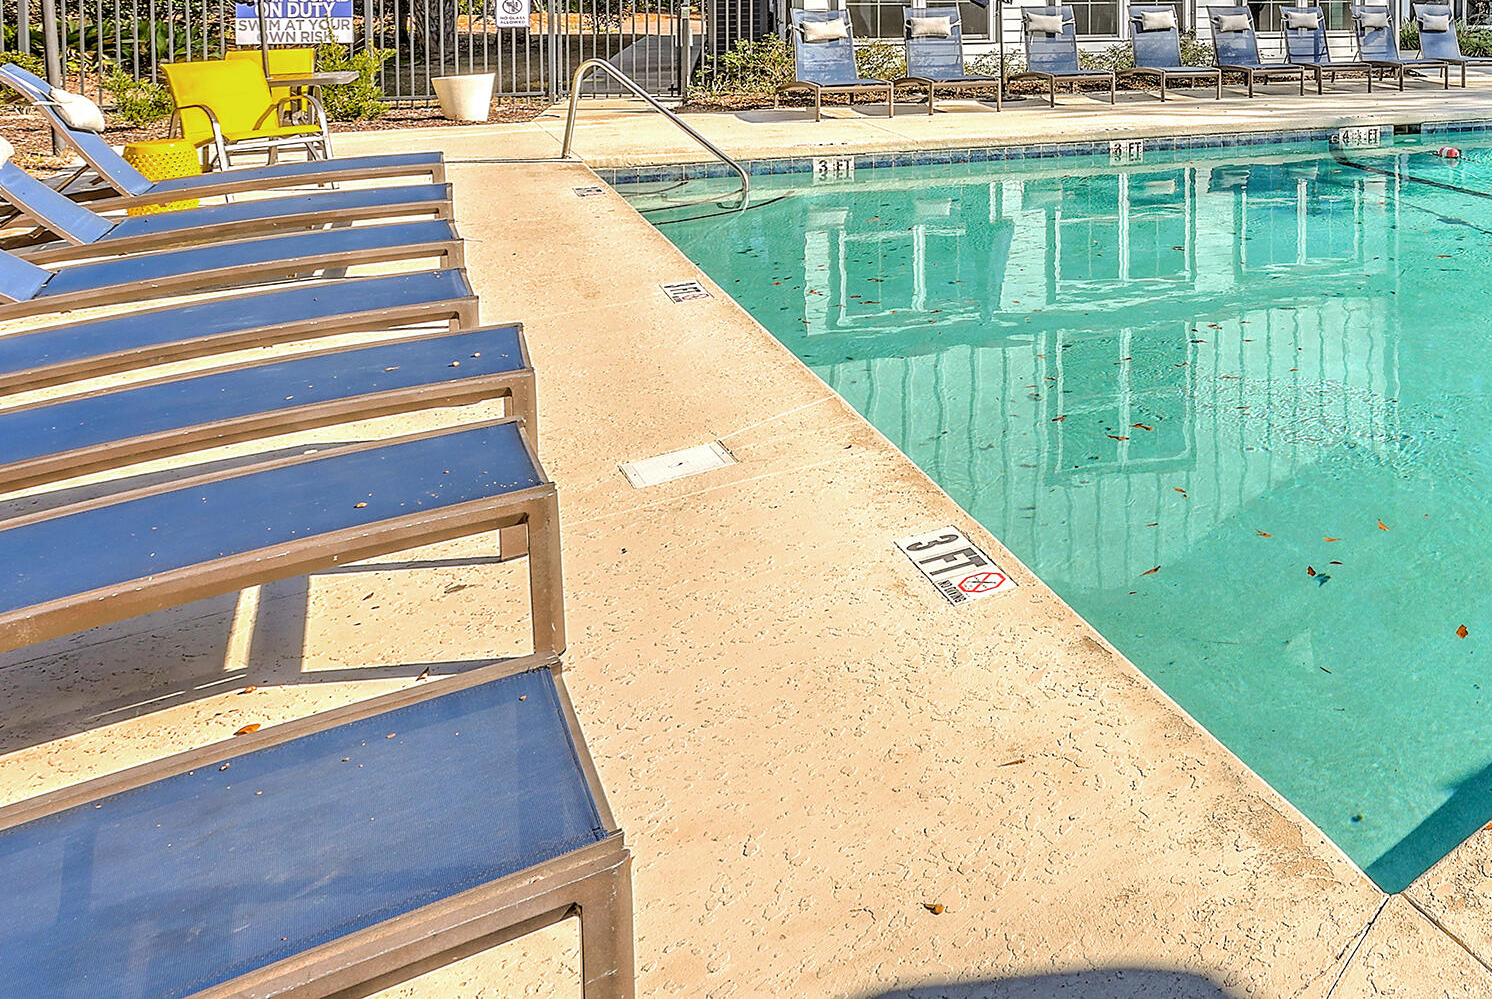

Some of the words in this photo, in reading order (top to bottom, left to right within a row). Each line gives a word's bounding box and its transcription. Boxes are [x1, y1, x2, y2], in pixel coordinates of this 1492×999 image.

[287, 2, 336, 18] DUTY
[284, 19, 304, 31] AT
[308, 19, 350, 31] YOUR
[906, 534, 959, 552] 3
[919, 547, 988, 577] FT
